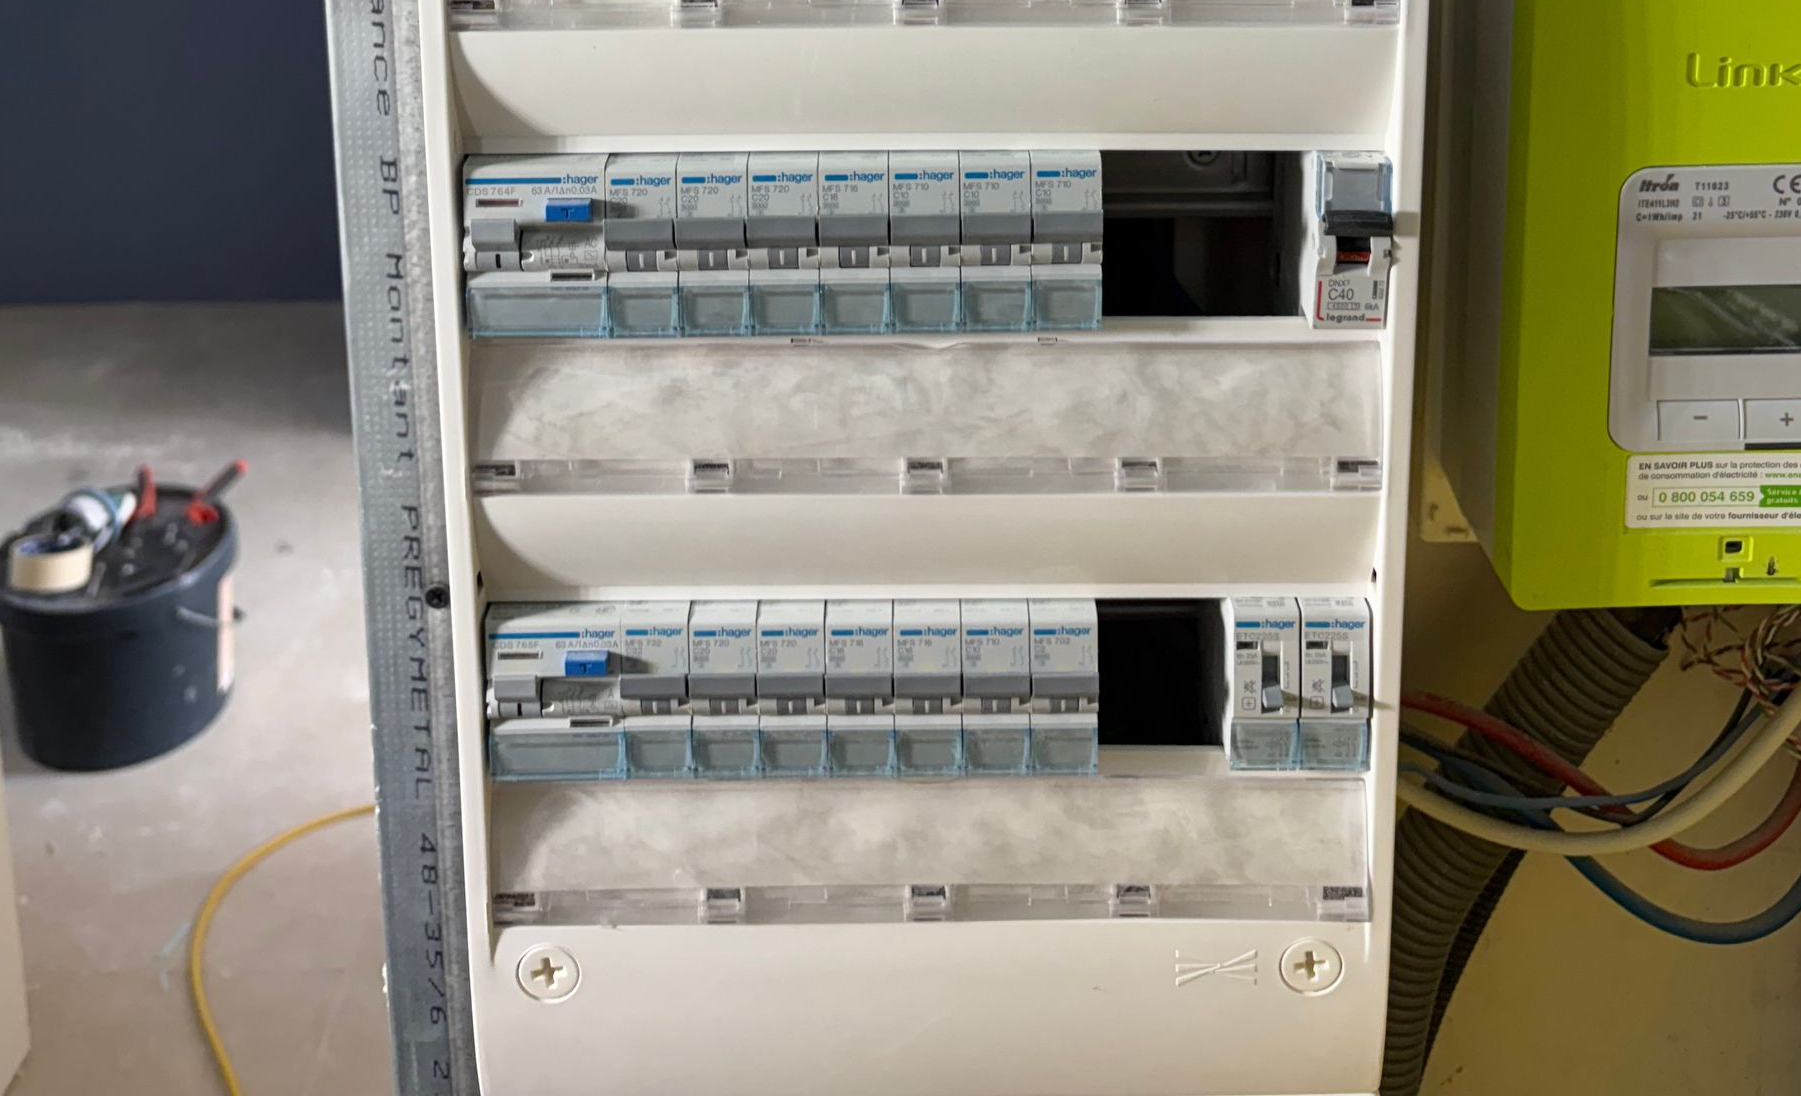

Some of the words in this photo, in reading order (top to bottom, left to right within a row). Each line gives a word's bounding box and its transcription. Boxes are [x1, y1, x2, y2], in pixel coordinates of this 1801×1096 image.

[466, 187, 489, 196] CDS
[1328, 288, 1354, 301] C40
[1326, 314, 1365, 323] legrand
[1638, 462, 1652, 471] EN
[1653, 462, 1688, 470] SAVOIR
[1690, 461, 1713, 469] PLUS
[1715, 461, 1729, 469] sur
[1730, 461, 1738, 469] la
[1739, 461, 1781, 470] protection
[1783, 460, 1798, 468] des
[1638, 472, 1649, 480] de
[1650, 471, 1711, 480] consommation
[1658, 492, 1667, 502] 0
[1671, 491, 1696, 502] 800
[1700, 491, 1725, 502] 054
[1729, 490, 1755, 502] 659
[1636, 513, 1647, 521] ou
[1649, 513, 1663, 521] sur
[1664, 512, 1673, 520] le
[1674, 512, 1690, 520] site
[1692, 511, 1703, 520] de
[1704, 512, 1726, 520] votre
[1728, 511, 1779, 520] fournisseur
[380, 156, 400, 214] BP
[401, 505, 433, 799] PREGYMETAL
[420, 832, 447, 1025] 48-35/6
